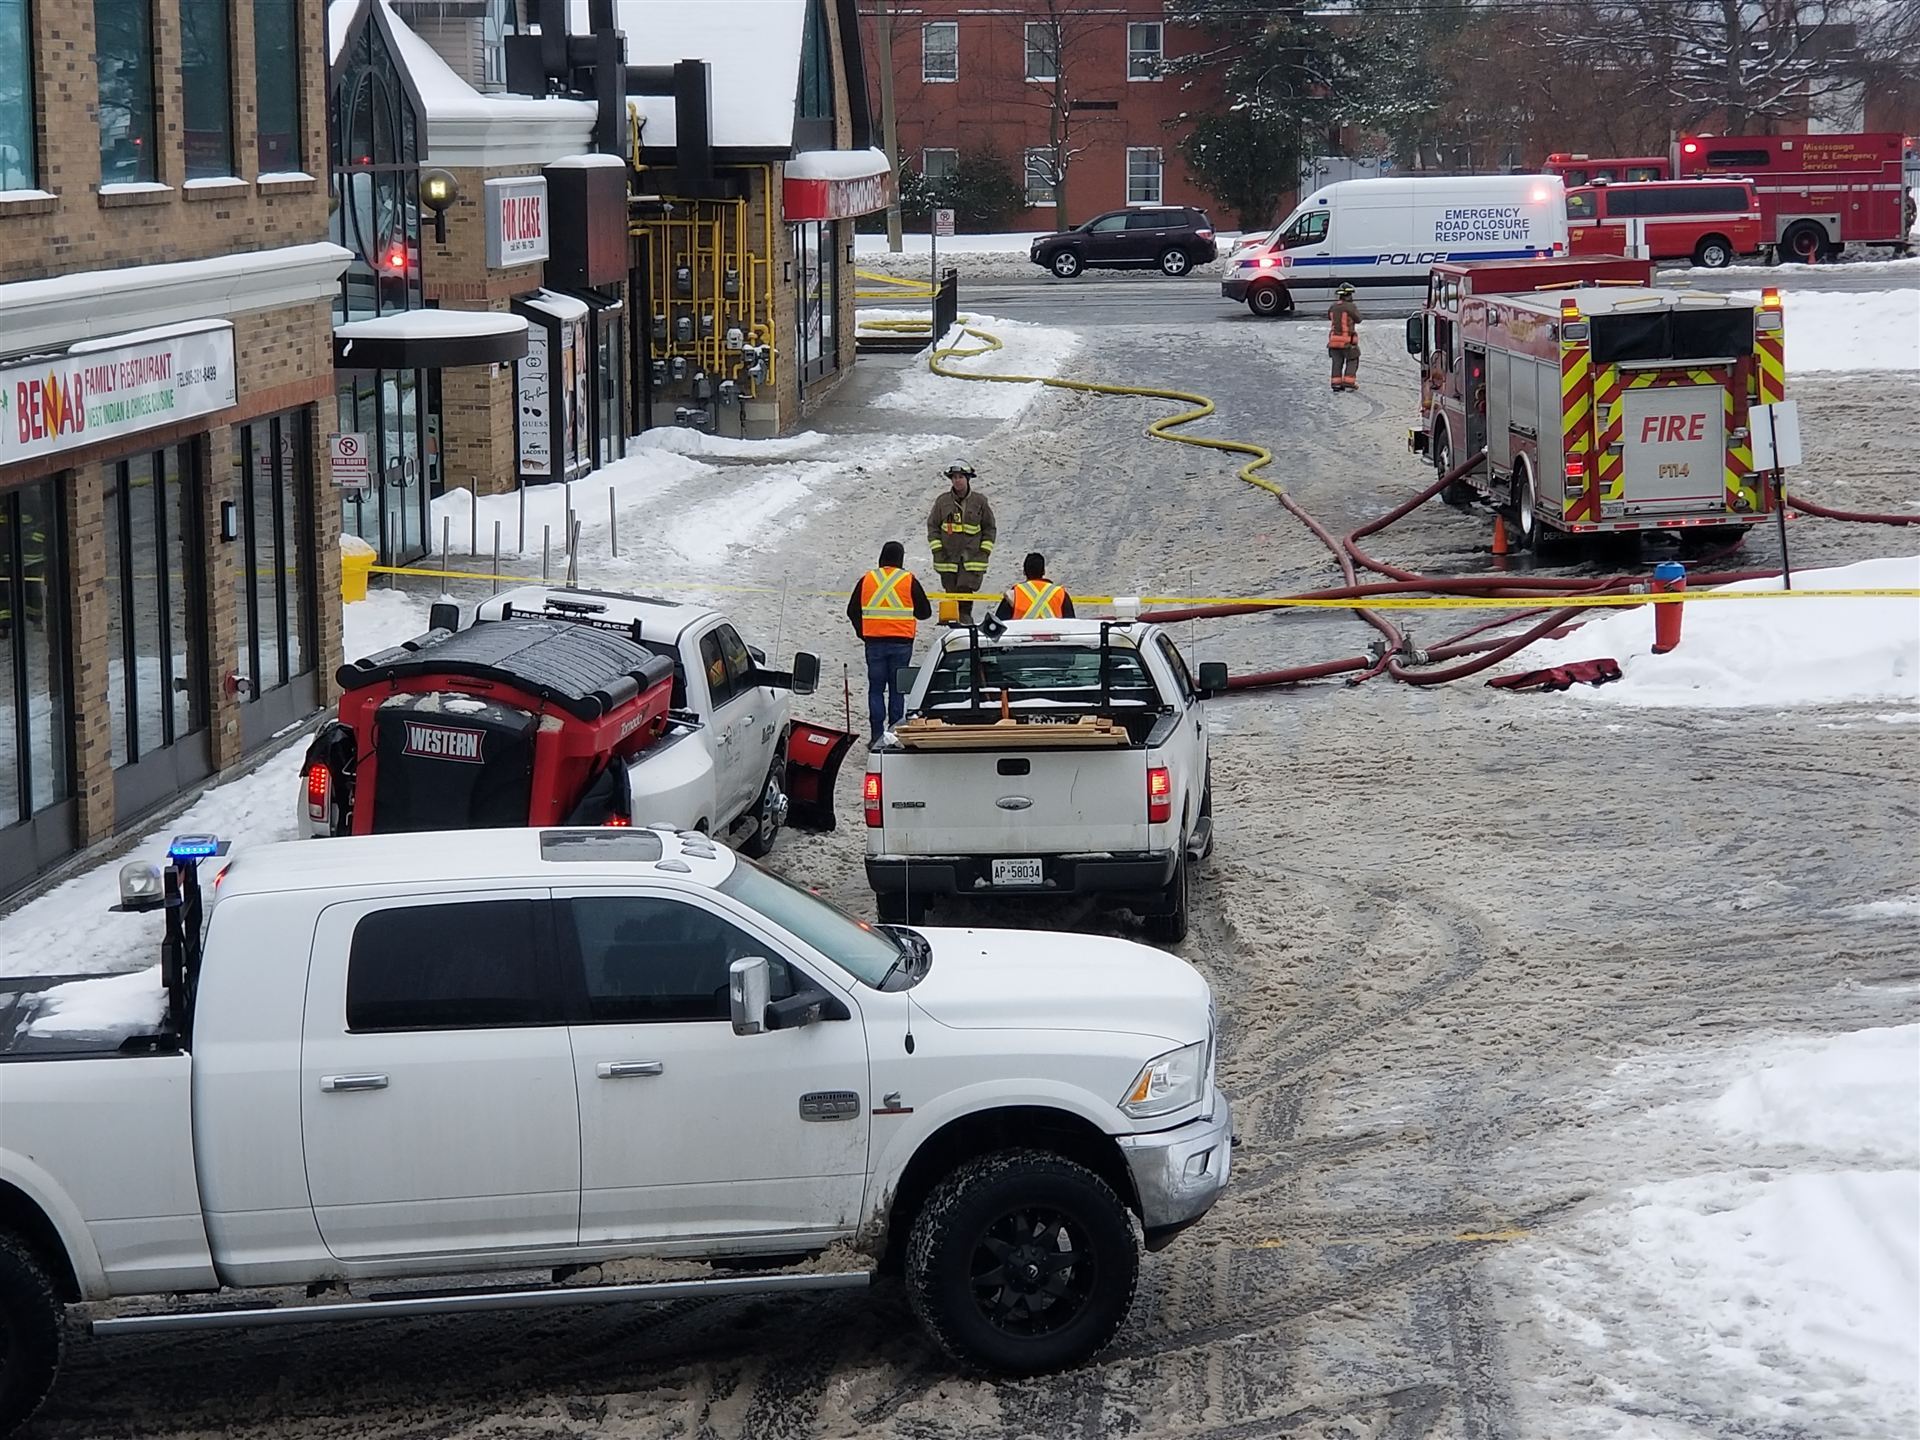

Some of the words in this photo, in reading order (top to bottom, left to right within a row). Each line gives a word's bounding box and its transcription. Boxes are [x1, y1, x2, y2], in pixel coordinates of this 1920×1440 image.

[1803, 143, 1855, 153] Mississauga
[1803, 152, 1819, 160] Fire
[1832, 152, 1878, 161] Emergency
[1802, 162, 1838, 170] Services
[503, 198, 517, 242] FOR
[519, 196, 541, 240] LEASE
[1445, 208, 1521, 220] EMERGENCY
[1435, 220, 1470, 231] ROAD
[1473, 218, 1530, 230] CLOSURE
[1435, 231, 1500, 242] RESPONSE
[1503, 230, 1530, 241] UNIT
[1376, 252, 1449, 266] POLICE
[85, 363, 117, 396] FAMILY
[120, 353, 172, 390] RESTAURANT
[17, 372, 85, 444] BENAB
[103, 401, 125, 424] INDIAN
[131, 394, 152, 418] CHINESE
[152, 389, 174, 412] CUISINE
[1640, 413, 1706, 444] FIRE
[1658, 463, 1690, 479] P114
[512, 611, 548, 620] BACK
[593, 621, 630, 631] RACK
[411, 726, 478, 757] WESTERN
[803, 1101, 857, 1115] RAM
